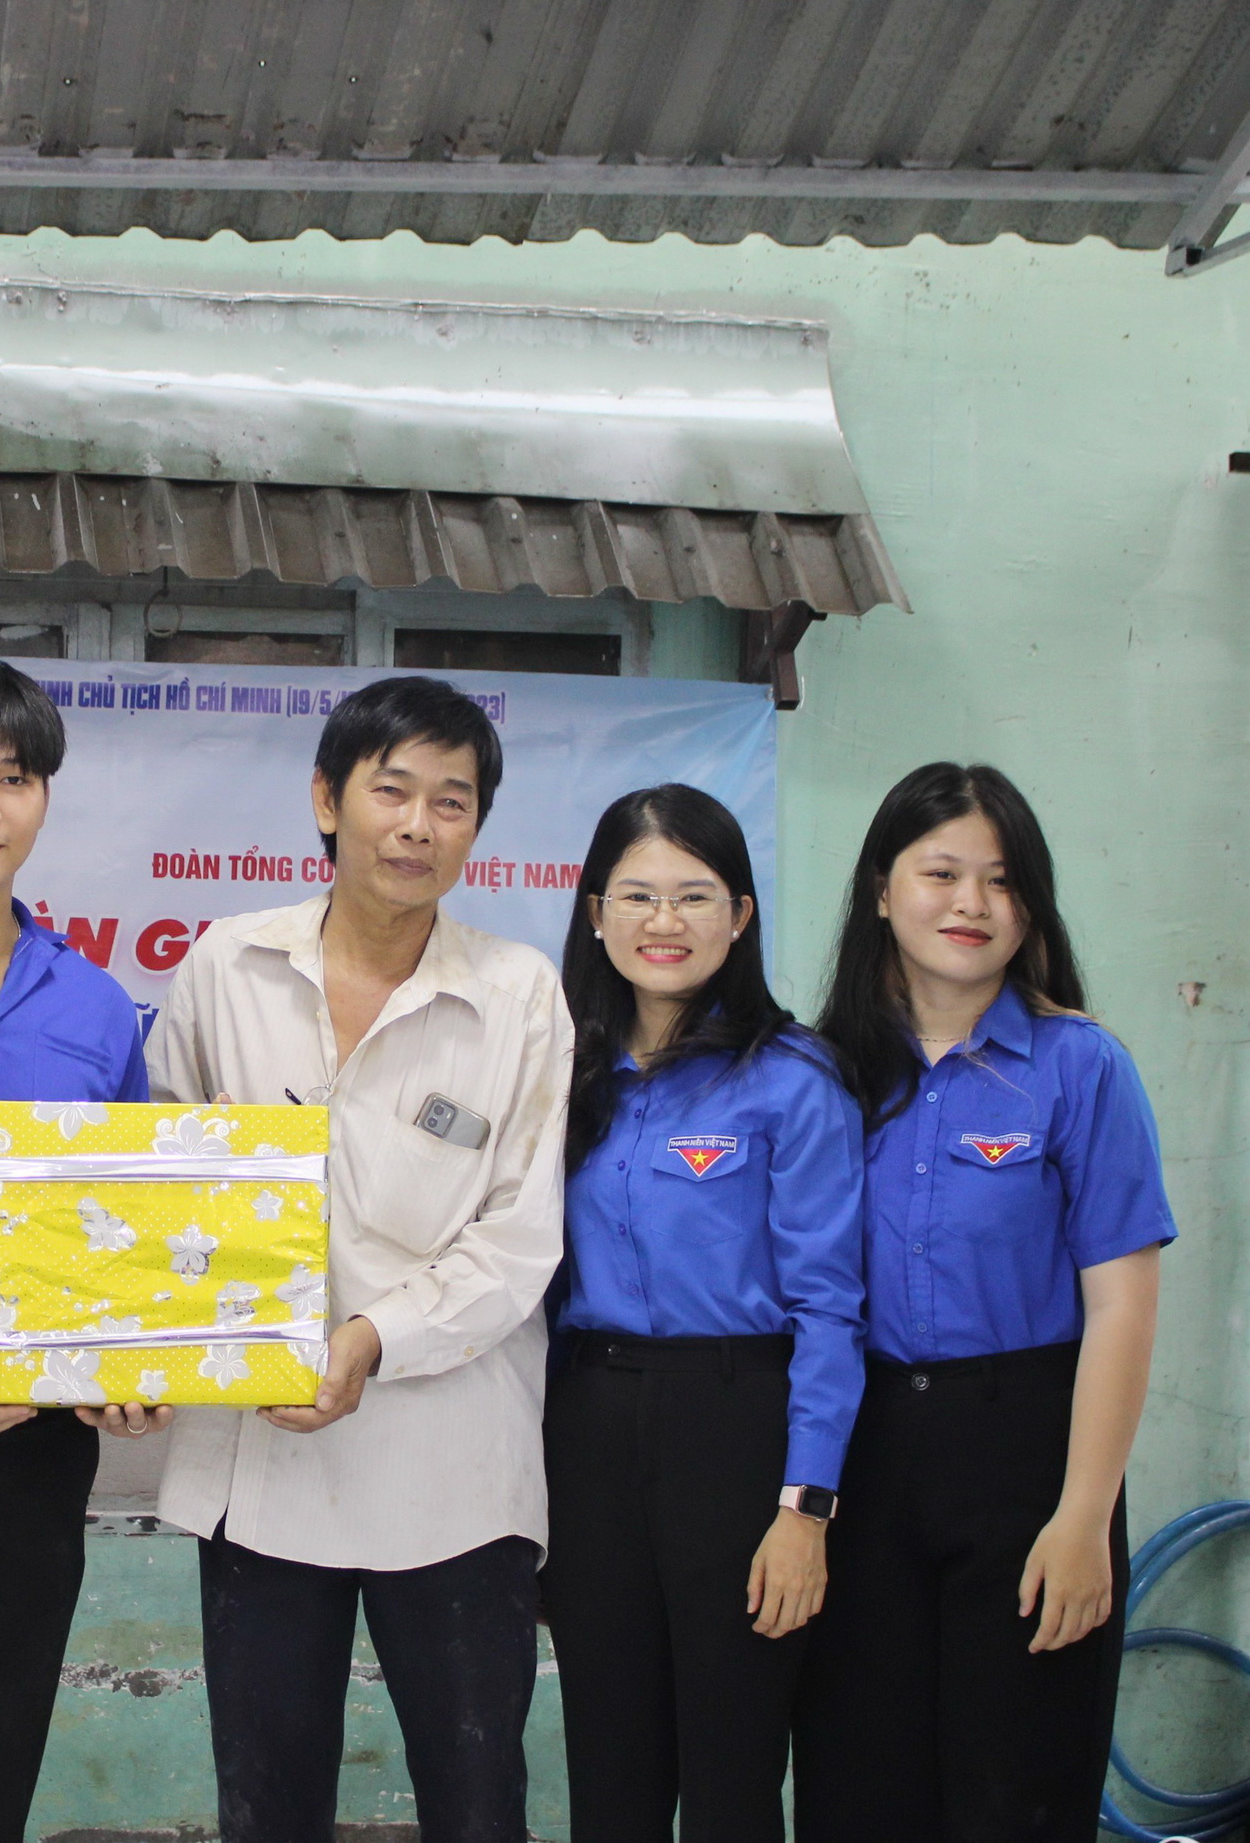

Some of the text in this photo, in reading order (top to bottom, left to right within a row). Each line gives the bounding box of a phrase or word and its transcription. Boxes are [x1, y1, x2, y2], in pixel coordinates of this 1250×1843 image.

[78, 675, 115, 709] CHỦ
[120, 683, 160, 715] TỊCH
[165, 677, 190, 711] HỒ
[196, 682, 226, 712] CHÍ
[231, 686, 281, 714] MINH
[152, 848, 220, 880] ĐOÀN
[228, 845, 293, 882] TỔNG
[464, 856, 582, 893] VIỆT NAM
